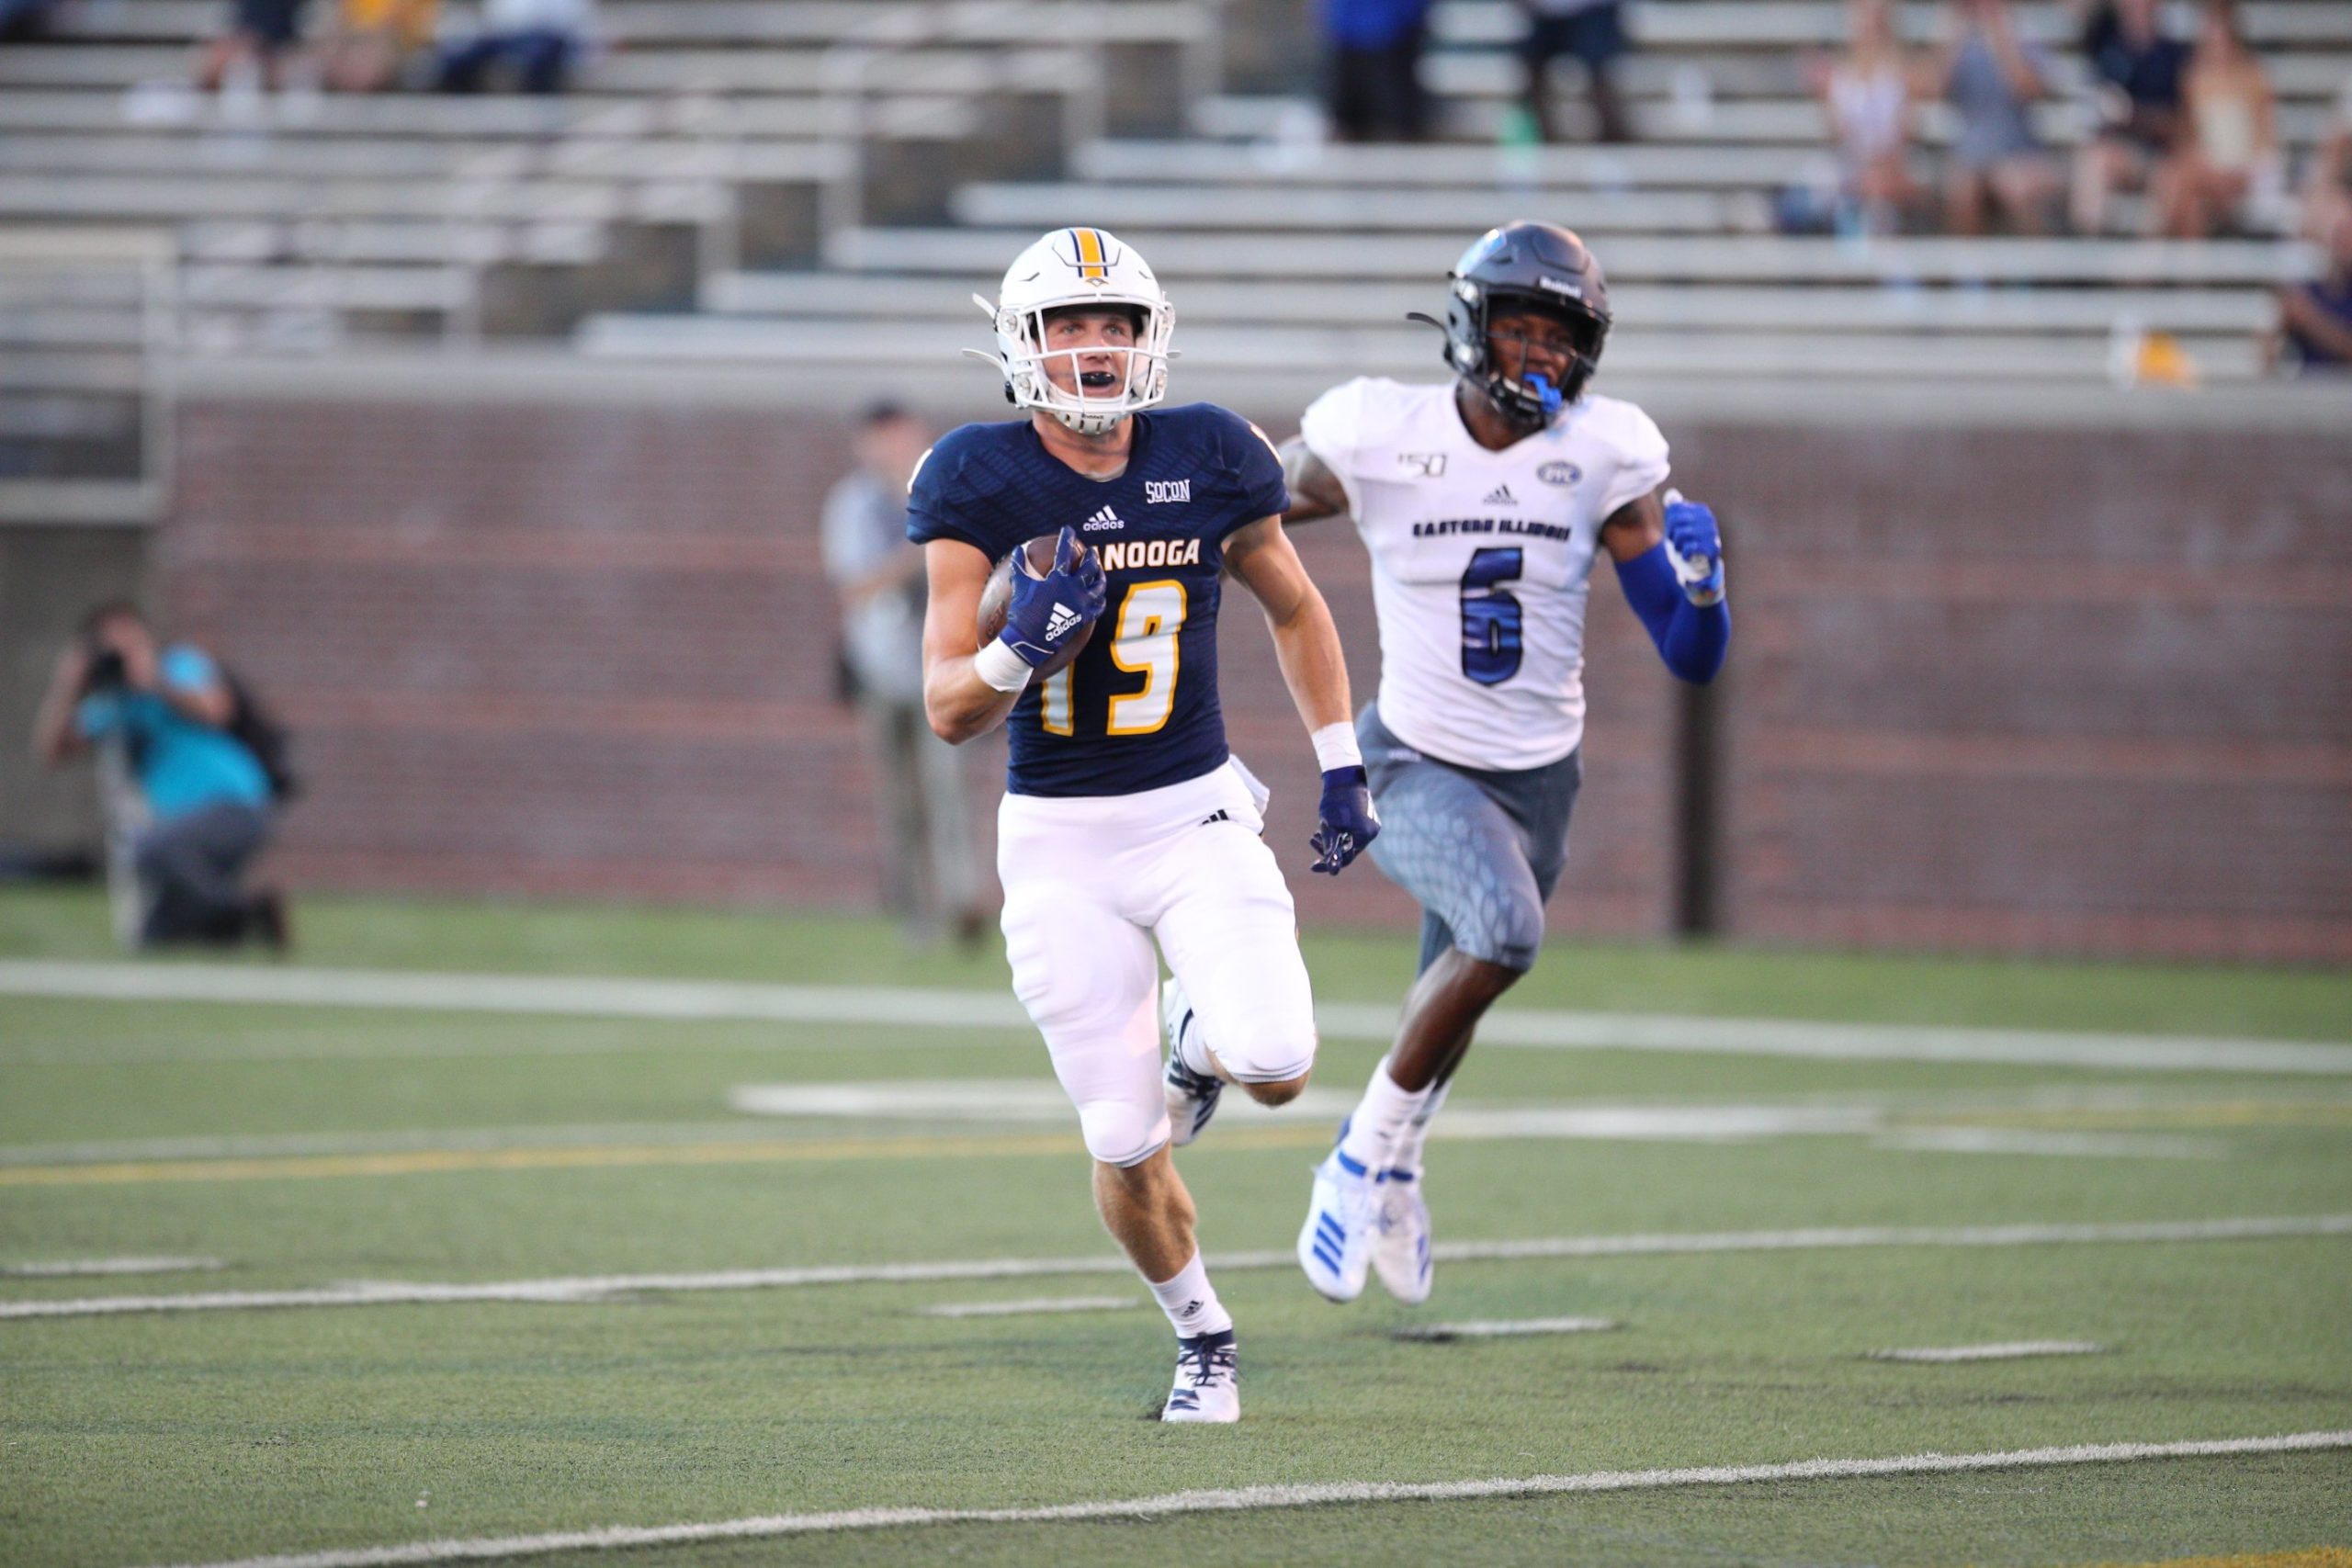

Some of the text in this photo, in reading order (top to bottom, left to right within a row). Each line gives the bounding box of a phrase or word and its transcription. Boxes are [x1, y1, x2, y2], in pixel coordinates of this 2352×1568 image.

[1145, 479, 1191, 503] SOCON
[1083, 518, 1125, 531] adidas
[1046, 614, 1082, 641] adidas
[1460, 547, 1522, 686] 6
